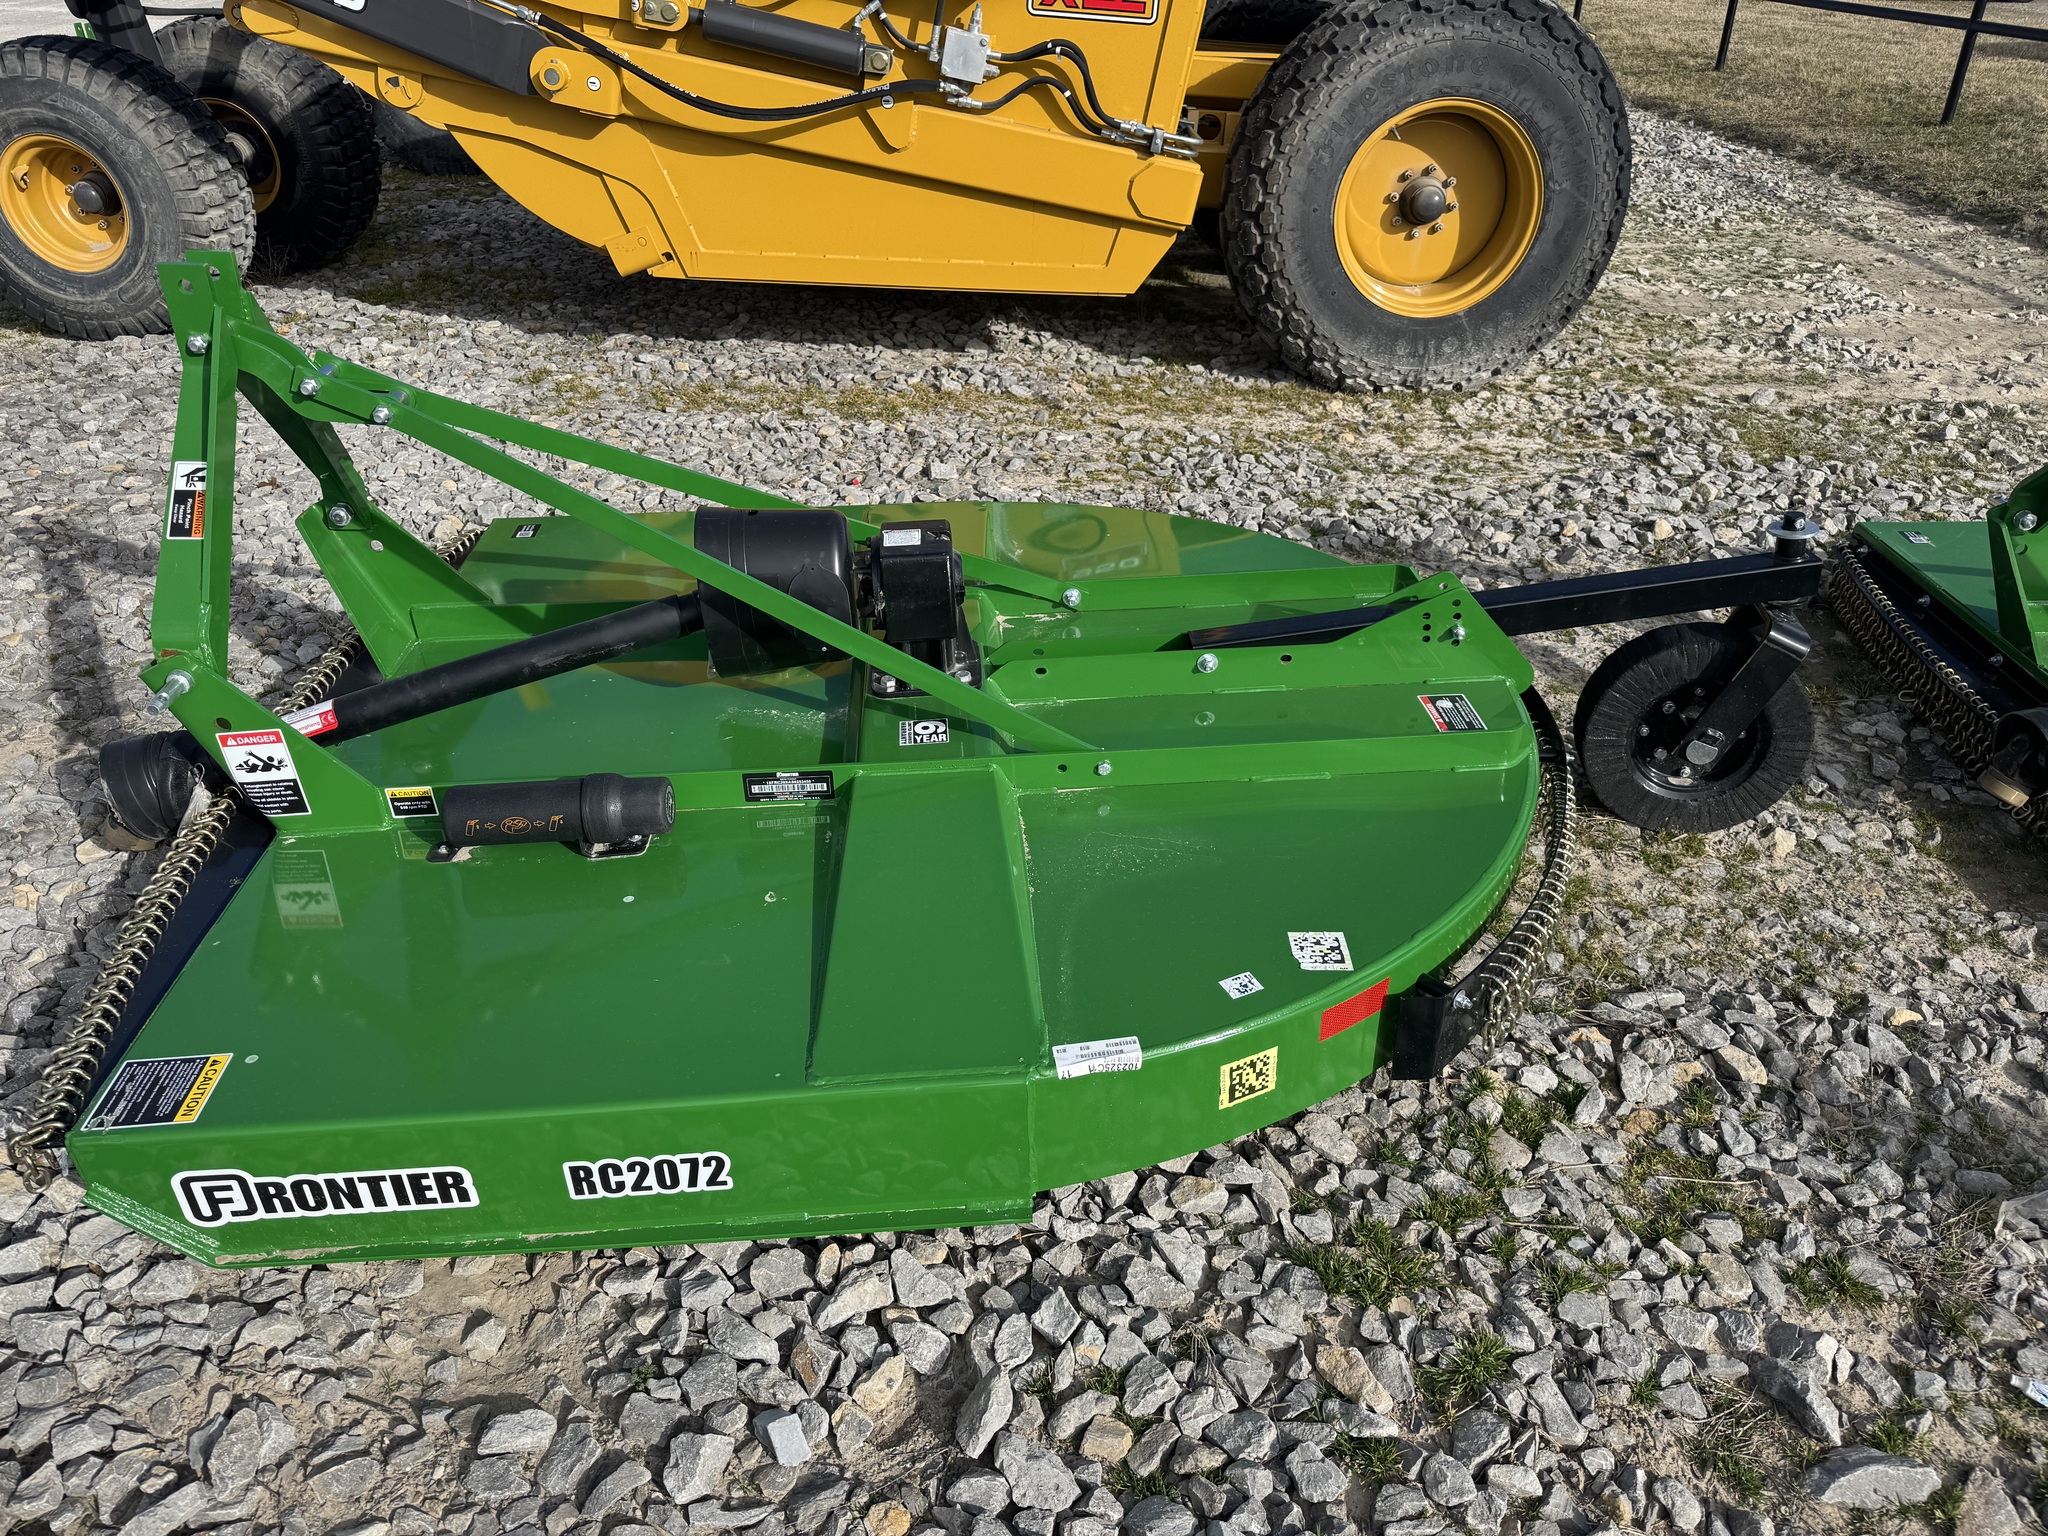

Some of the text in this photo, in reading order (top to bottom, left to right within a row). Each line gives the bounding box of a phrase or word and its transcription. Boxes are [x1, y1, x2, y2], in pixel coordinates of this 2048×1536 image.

[1313, 54, 1491, 158] Firestone
[193, 498, 205, 535] WARNING
[236, 734, 277, 745] DANGER
[914, 734, 947, 743] YEAR
[180, 1068, 218, 1117] CAUTION
[568, 1155, 728, 1196] RC2072
[180, 1171, 471, 1222] FRONTIER
